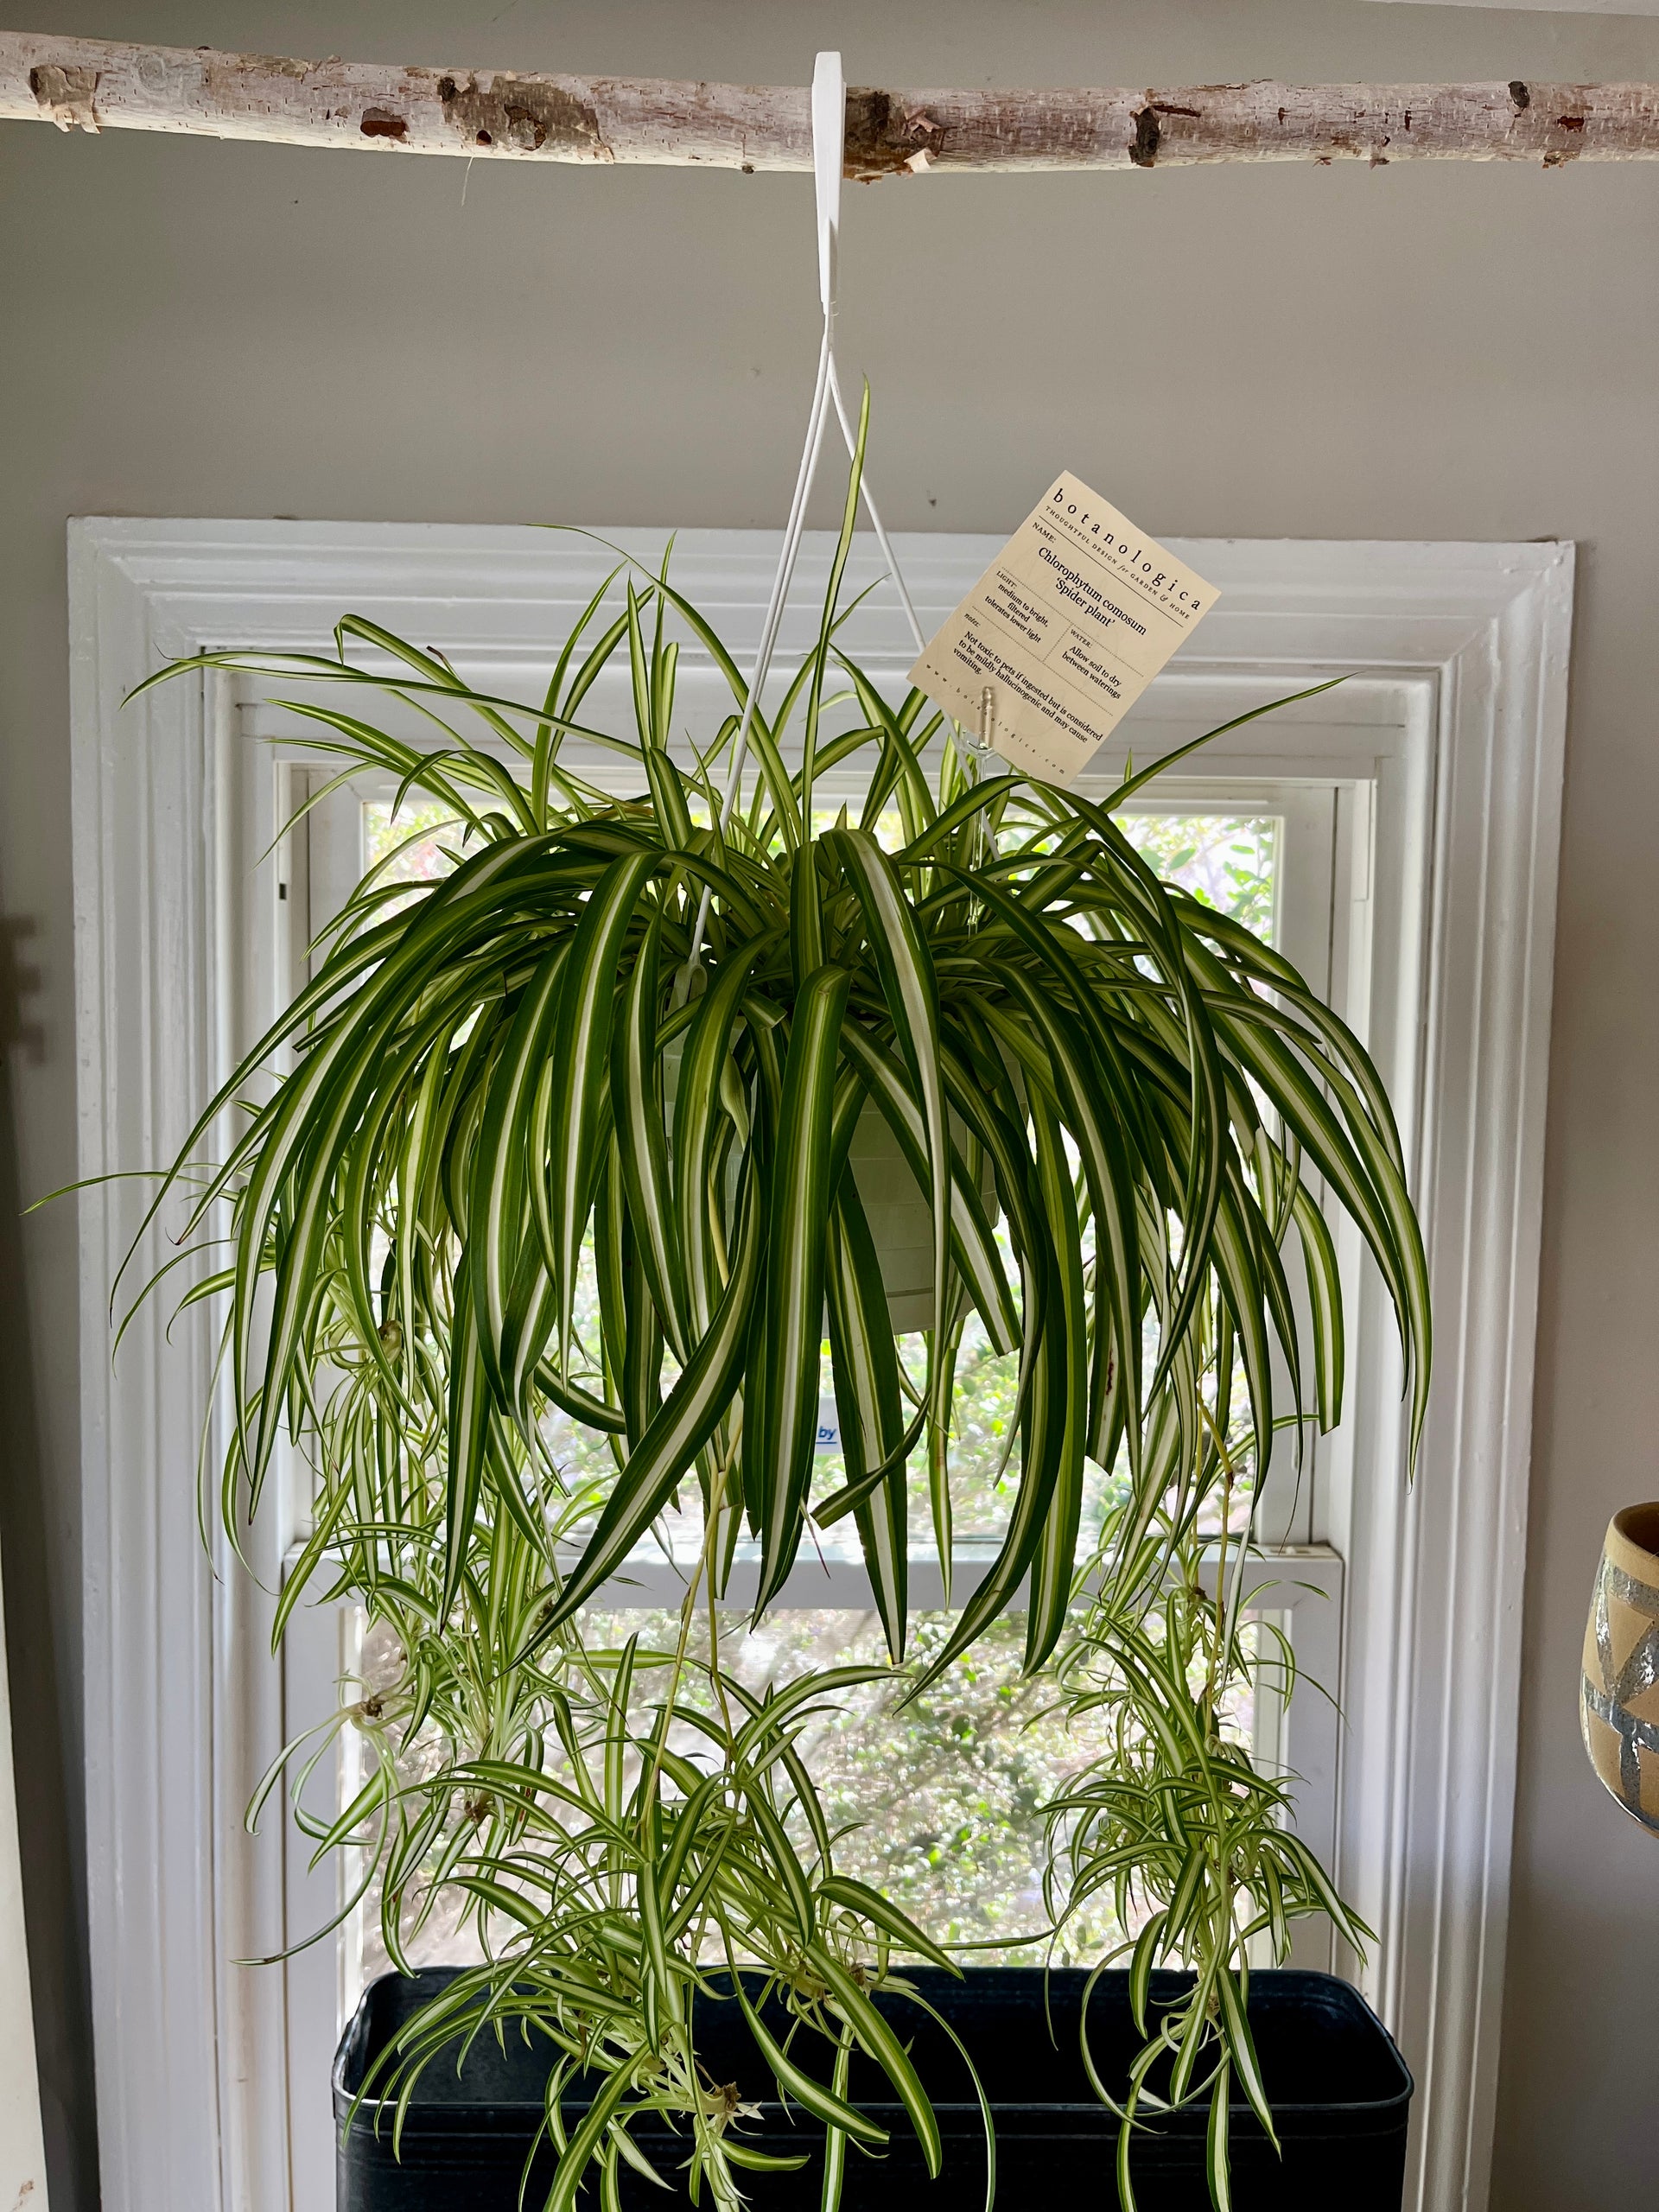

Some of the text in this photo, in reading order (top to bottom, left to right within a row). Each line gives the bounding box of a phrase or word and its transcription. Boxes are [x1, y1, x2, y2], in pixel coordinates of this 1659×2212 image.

[1032, 522, 1057, 543] NAME:
[1053, 488, 1201, 610] botanologica
[996, 570, 1018, 589] LIGHT:
[1046, 505, 1090, 543] THOUGHTFUL
[1091, 543, 1117, 565] DESIGN
[1117, 564, 1129, 574] for
[1130, 574, 1159, 596] GARDEN
[1169, 603, 1191, 620] HOME
[998, 584, 1049, 627] medium to bright,
[1039, 546, 1147, 636] Chlorophytum comosum
[964, 613, 981, 627] notes:
[985, 595, 1041, 643] tolerates lower light
[1007, 602, 1031, 623] filtered
[1071, 629, 1092, 648] WATER:
[953, 648, 982, 675] vomiting.
[1062, 651, 1121, 699] between waterings
[1069, 645, 1090, 663] Allow
[1089, 661, 1103, 672] soil
[1109, 675, 1122, 687] dry
[958, 639, 1088, 743] to be mildly hallucinogenic and may cause
[964, 631, 1103, 741] Not toxic to pets if ingested but is considered
[818, 1426, 836, 1440] by
